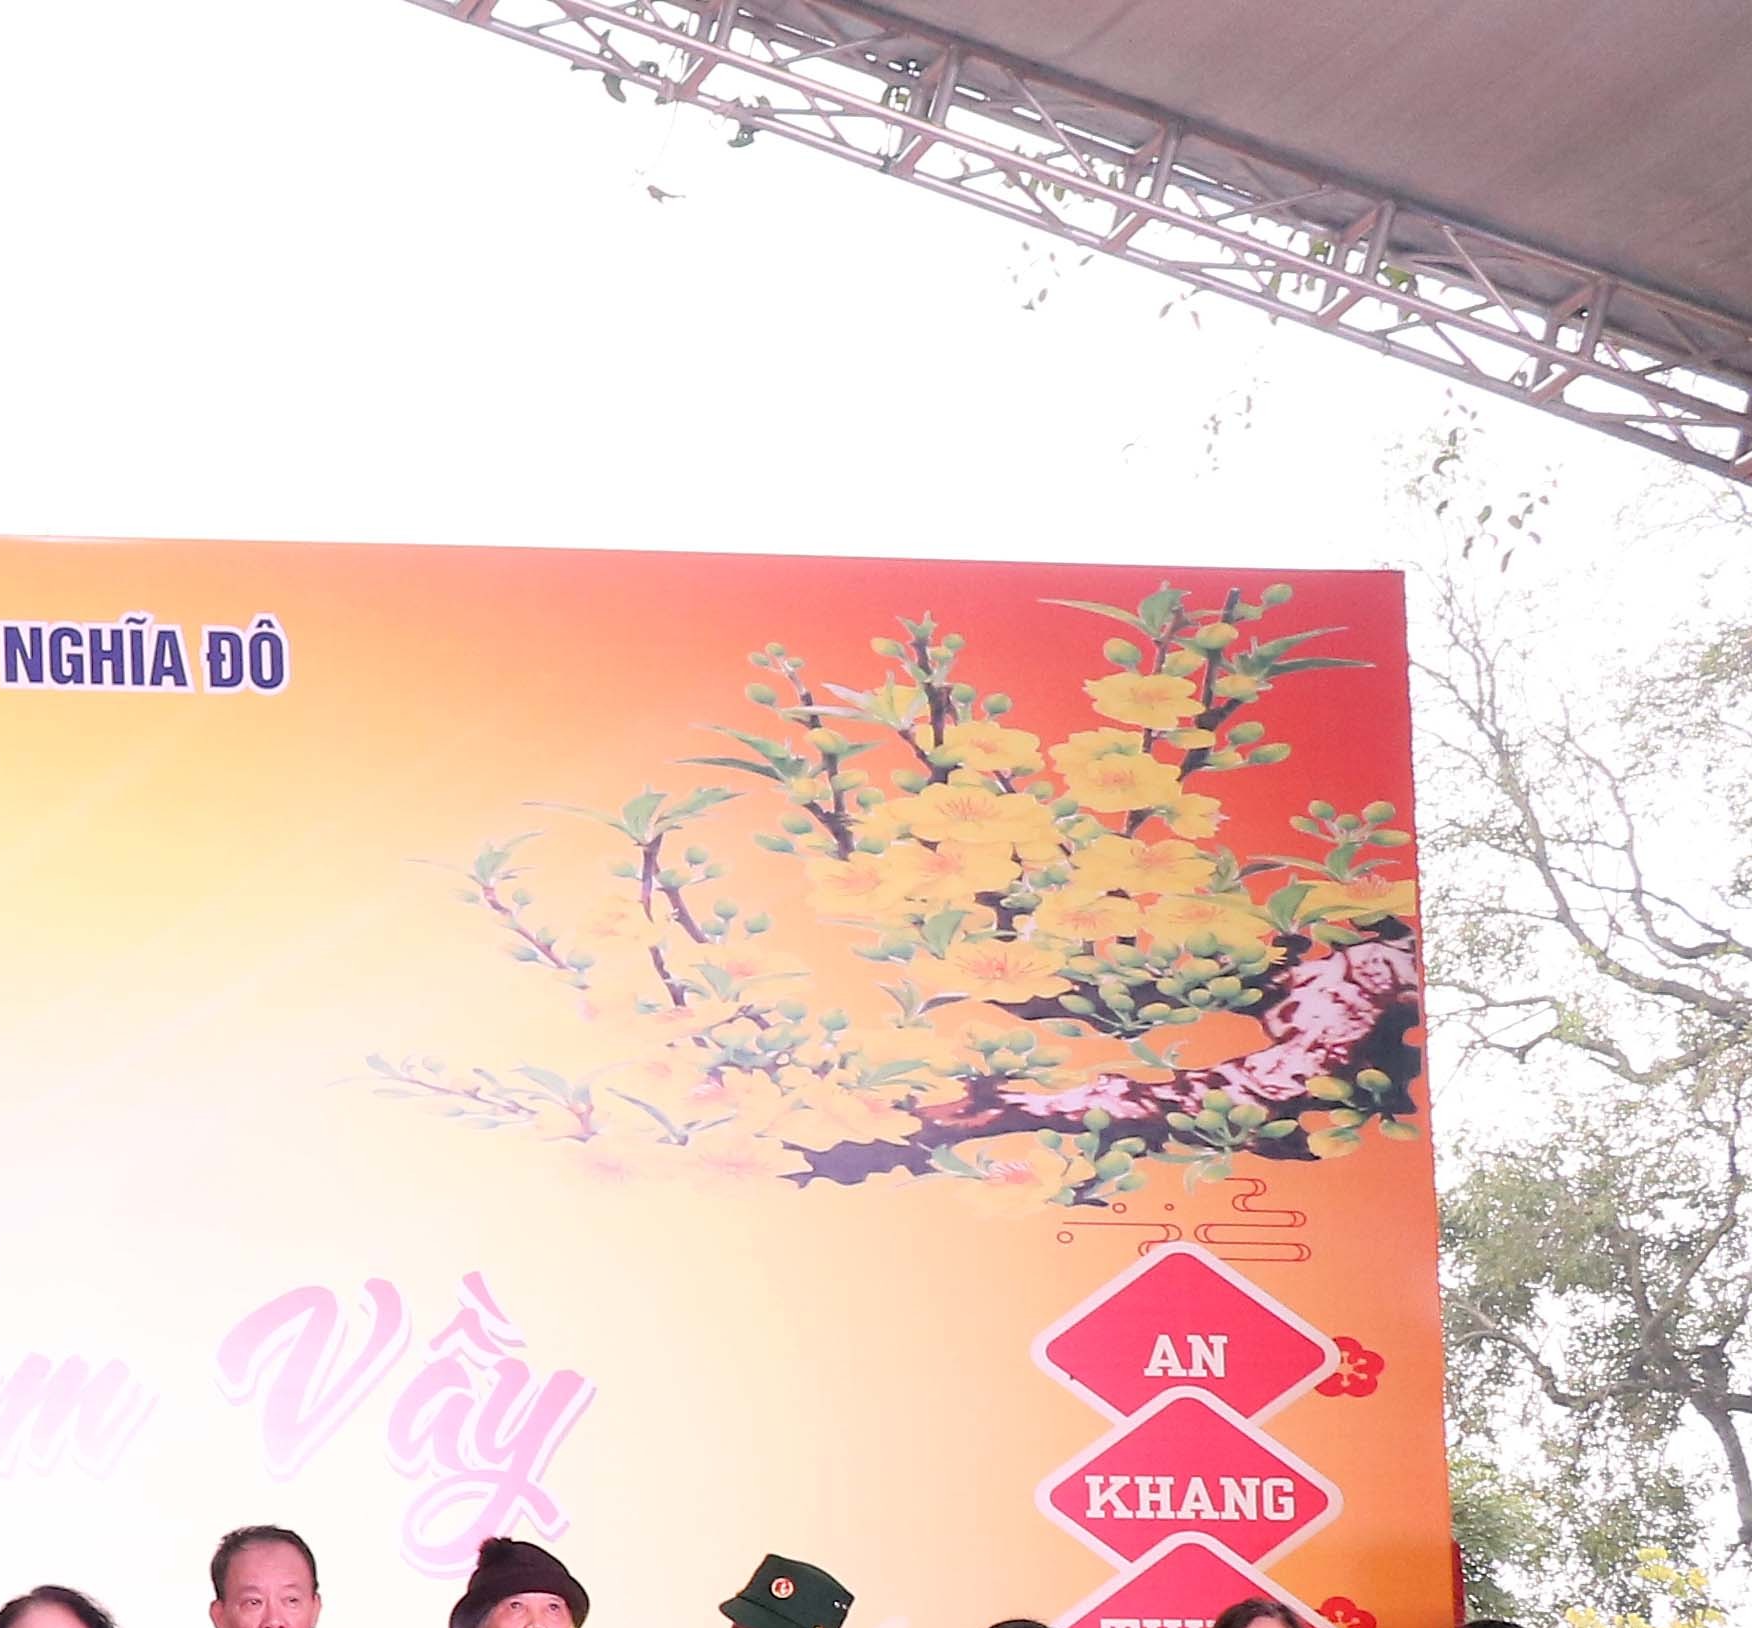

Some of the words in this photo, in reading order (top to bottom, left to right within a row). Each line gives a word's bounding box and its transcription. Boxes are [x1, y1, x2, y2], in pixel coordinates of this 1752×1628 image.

[3, 616, 188, 687] NGHĨA
[205, 619, 285, 690] ĐÔ
[1142, 1334, 1229, 1378] AN
[212, 1270, 592, 1572] Vầy
[1084, 1474, 1295, 1521] KHANG
